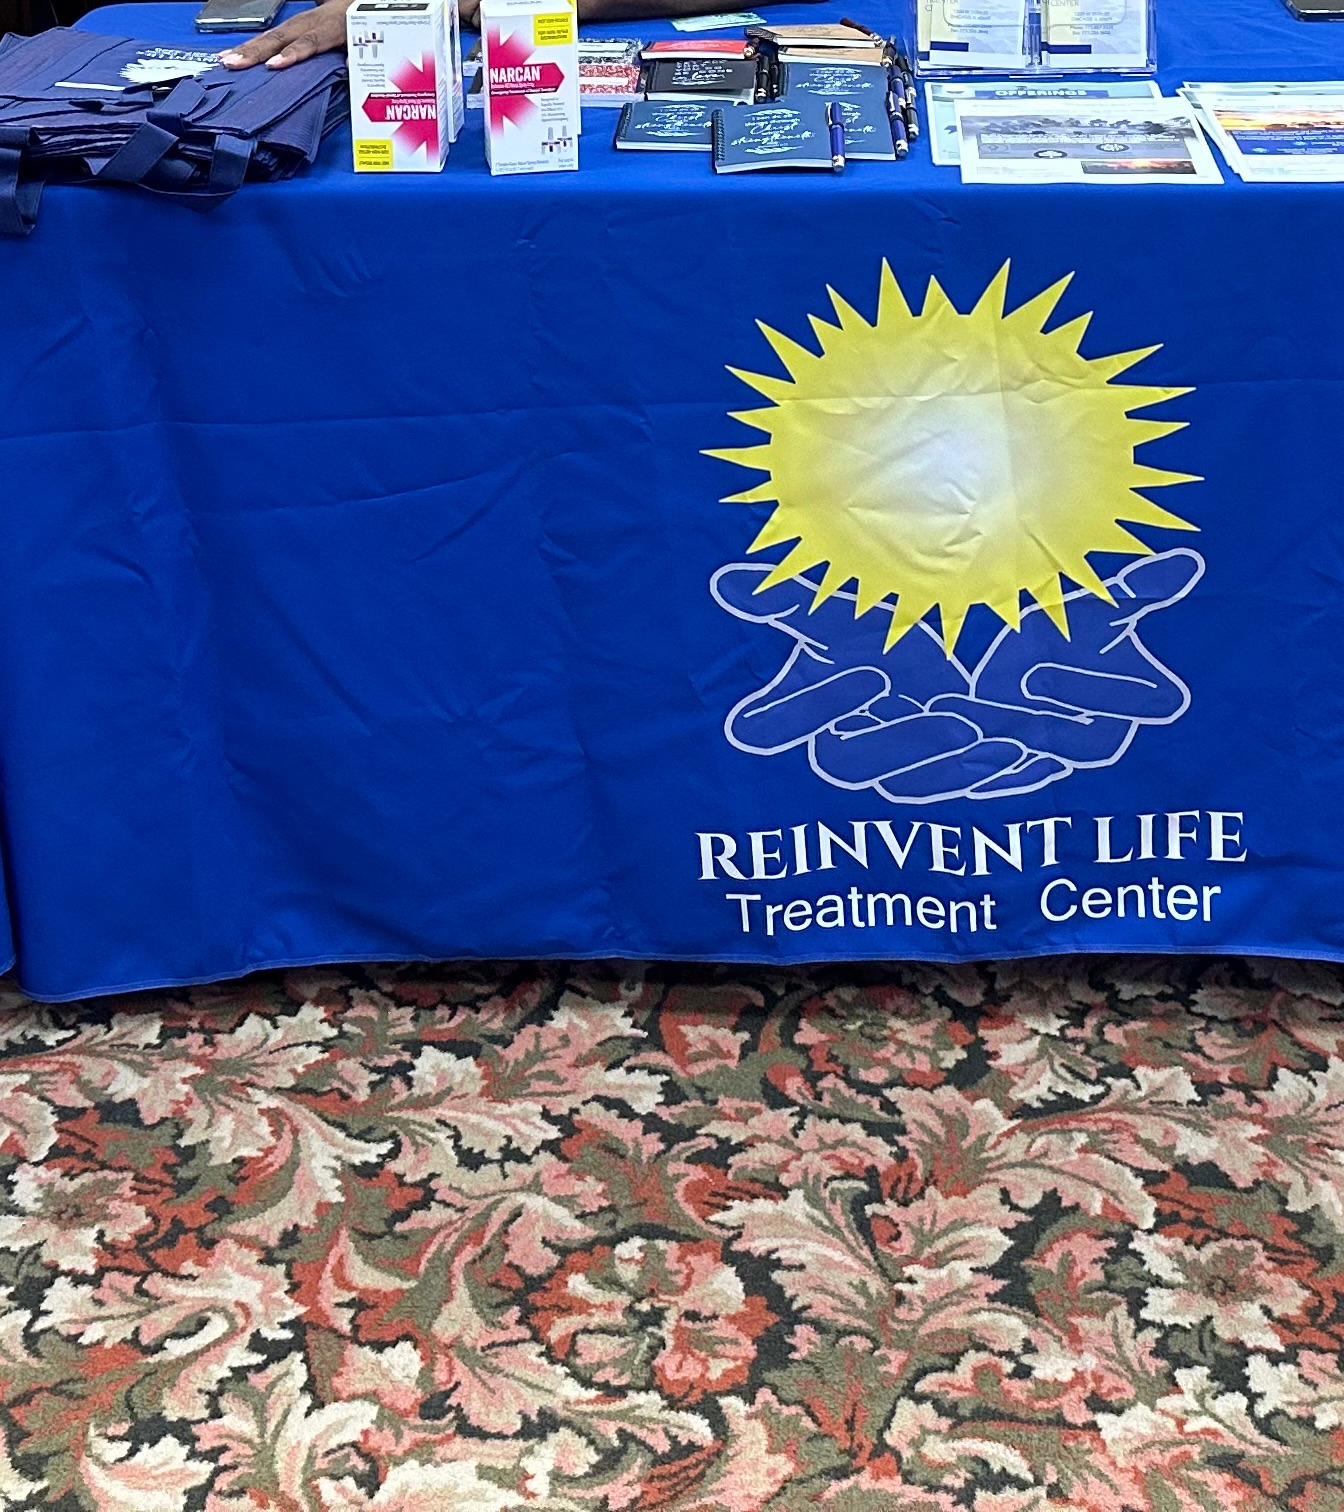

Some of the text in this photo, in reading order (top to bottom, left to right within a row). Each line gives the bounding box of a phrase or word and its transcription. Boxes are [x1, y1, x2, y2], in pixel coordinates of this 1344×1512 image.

[490, 65, 542, 83] NARCAN
[385, 104, 436, 120] NARCAN
[695, 810, 1248, 881] REINVENT LIFE
[726, 877, 1221, 936] Treatment Center
